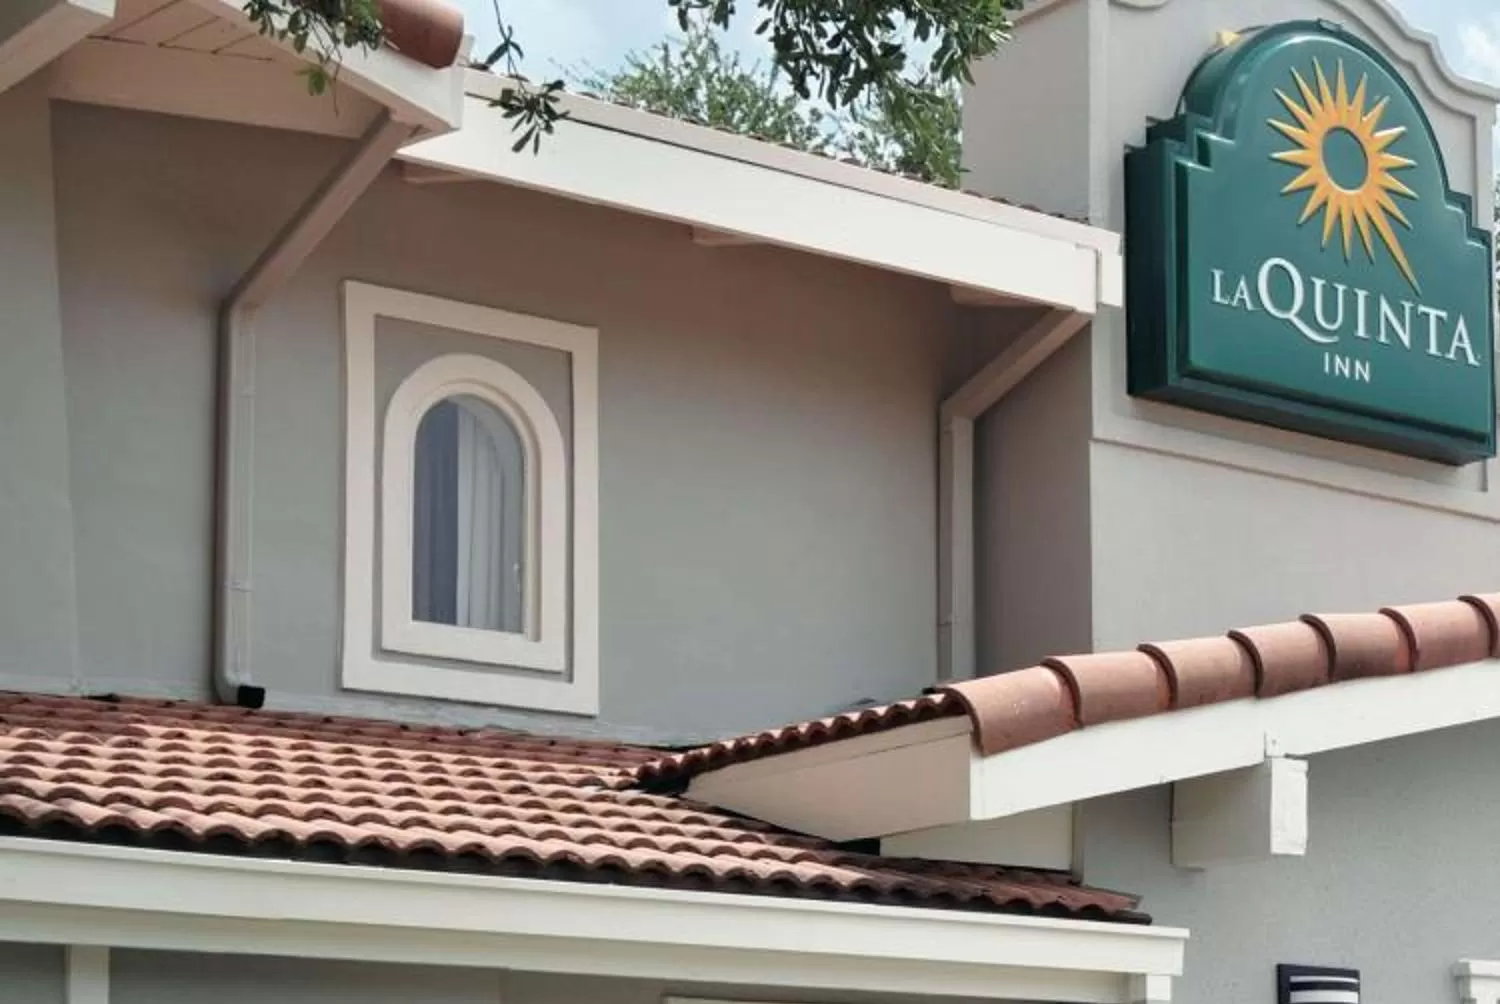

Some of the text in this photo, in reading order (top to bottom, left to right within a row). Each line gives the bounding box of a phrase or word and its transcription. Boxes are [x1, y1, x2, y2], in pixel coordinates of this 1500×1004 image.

[1210, 257, 1480, 367] LA QUINTA
[1323, 352, 1371, 384] INN
